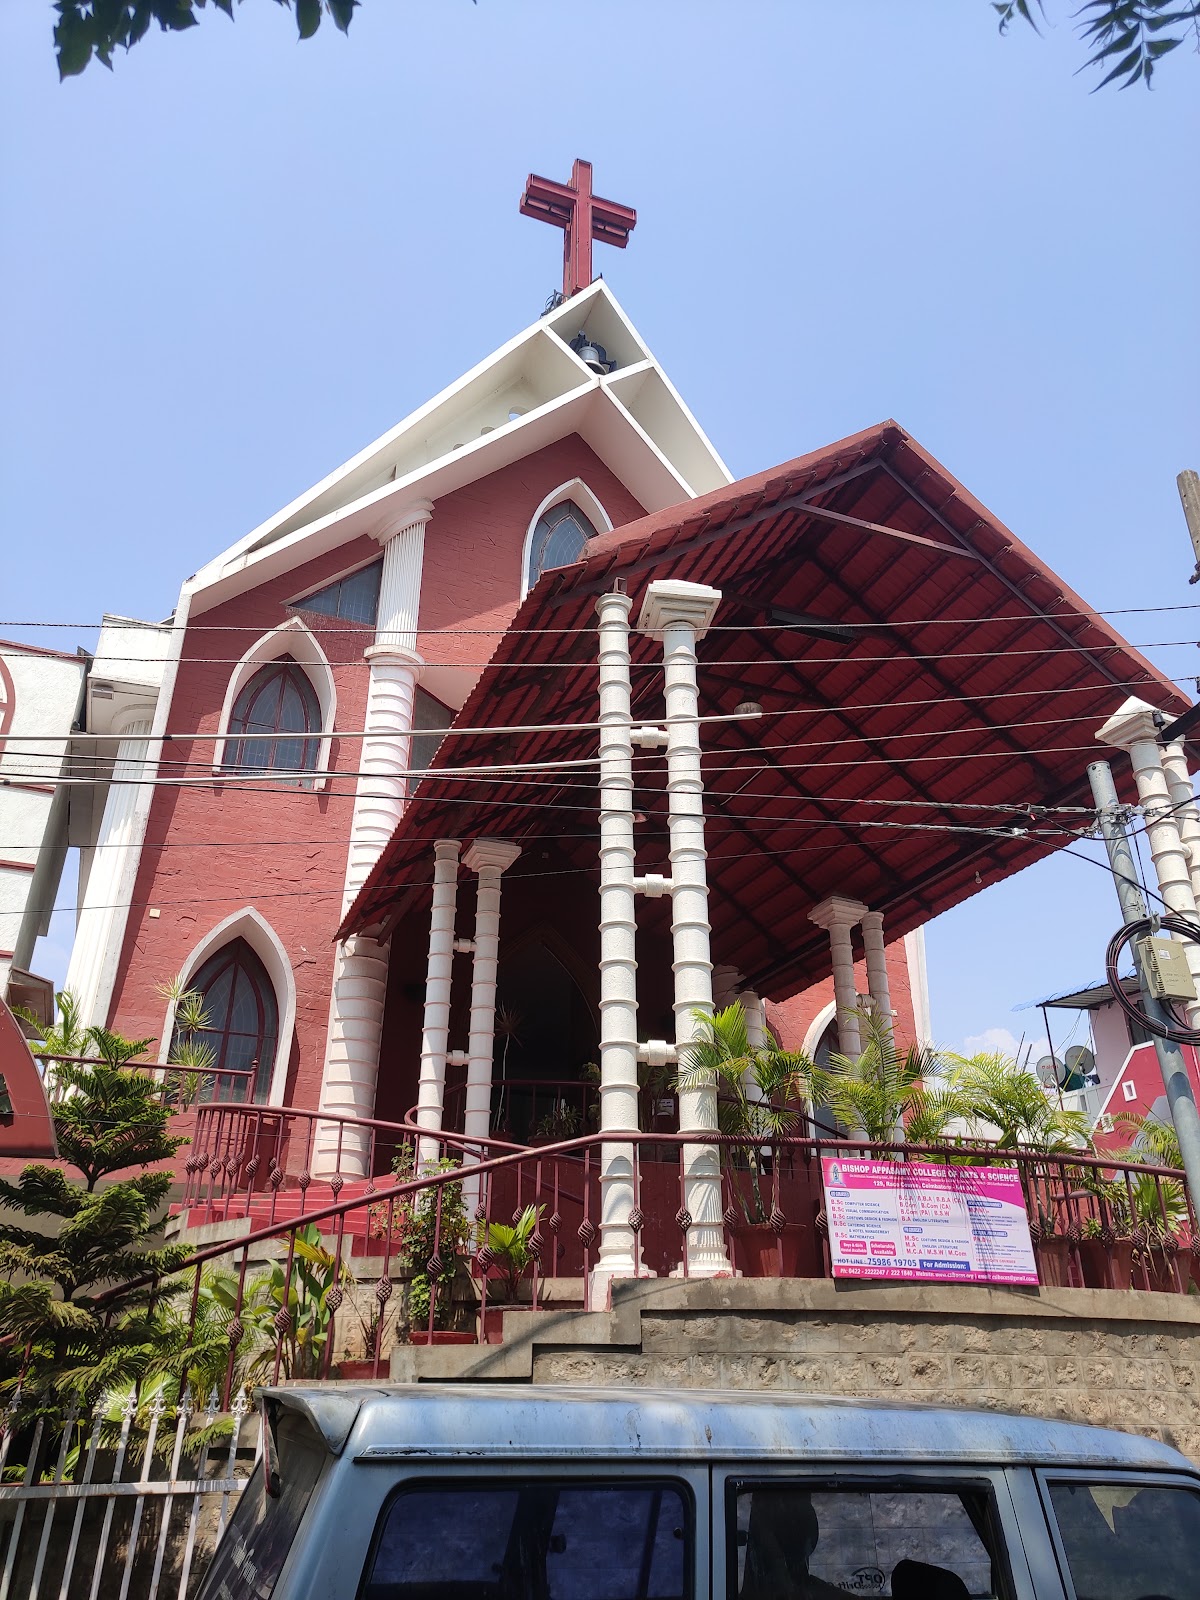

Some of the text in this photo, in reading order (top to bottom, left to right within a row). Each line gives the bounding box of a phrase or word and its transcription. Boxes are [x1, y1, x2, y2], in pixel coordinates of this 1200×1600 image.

[842, 1164, 870, 1173] BISHOP
[872, 1166, 911, 1175] APPASAMY
[913, 1168, 947, 1177] COLLEGE
[947, 1171, 958, 1179] OF
[959, 1171, 978, 1180] ARTS
[987, 1173, 1019, 1182] SCIENCE
[867, 1258, 892, 1267] 75986
[894, 1259, 917, 1268] 19705
